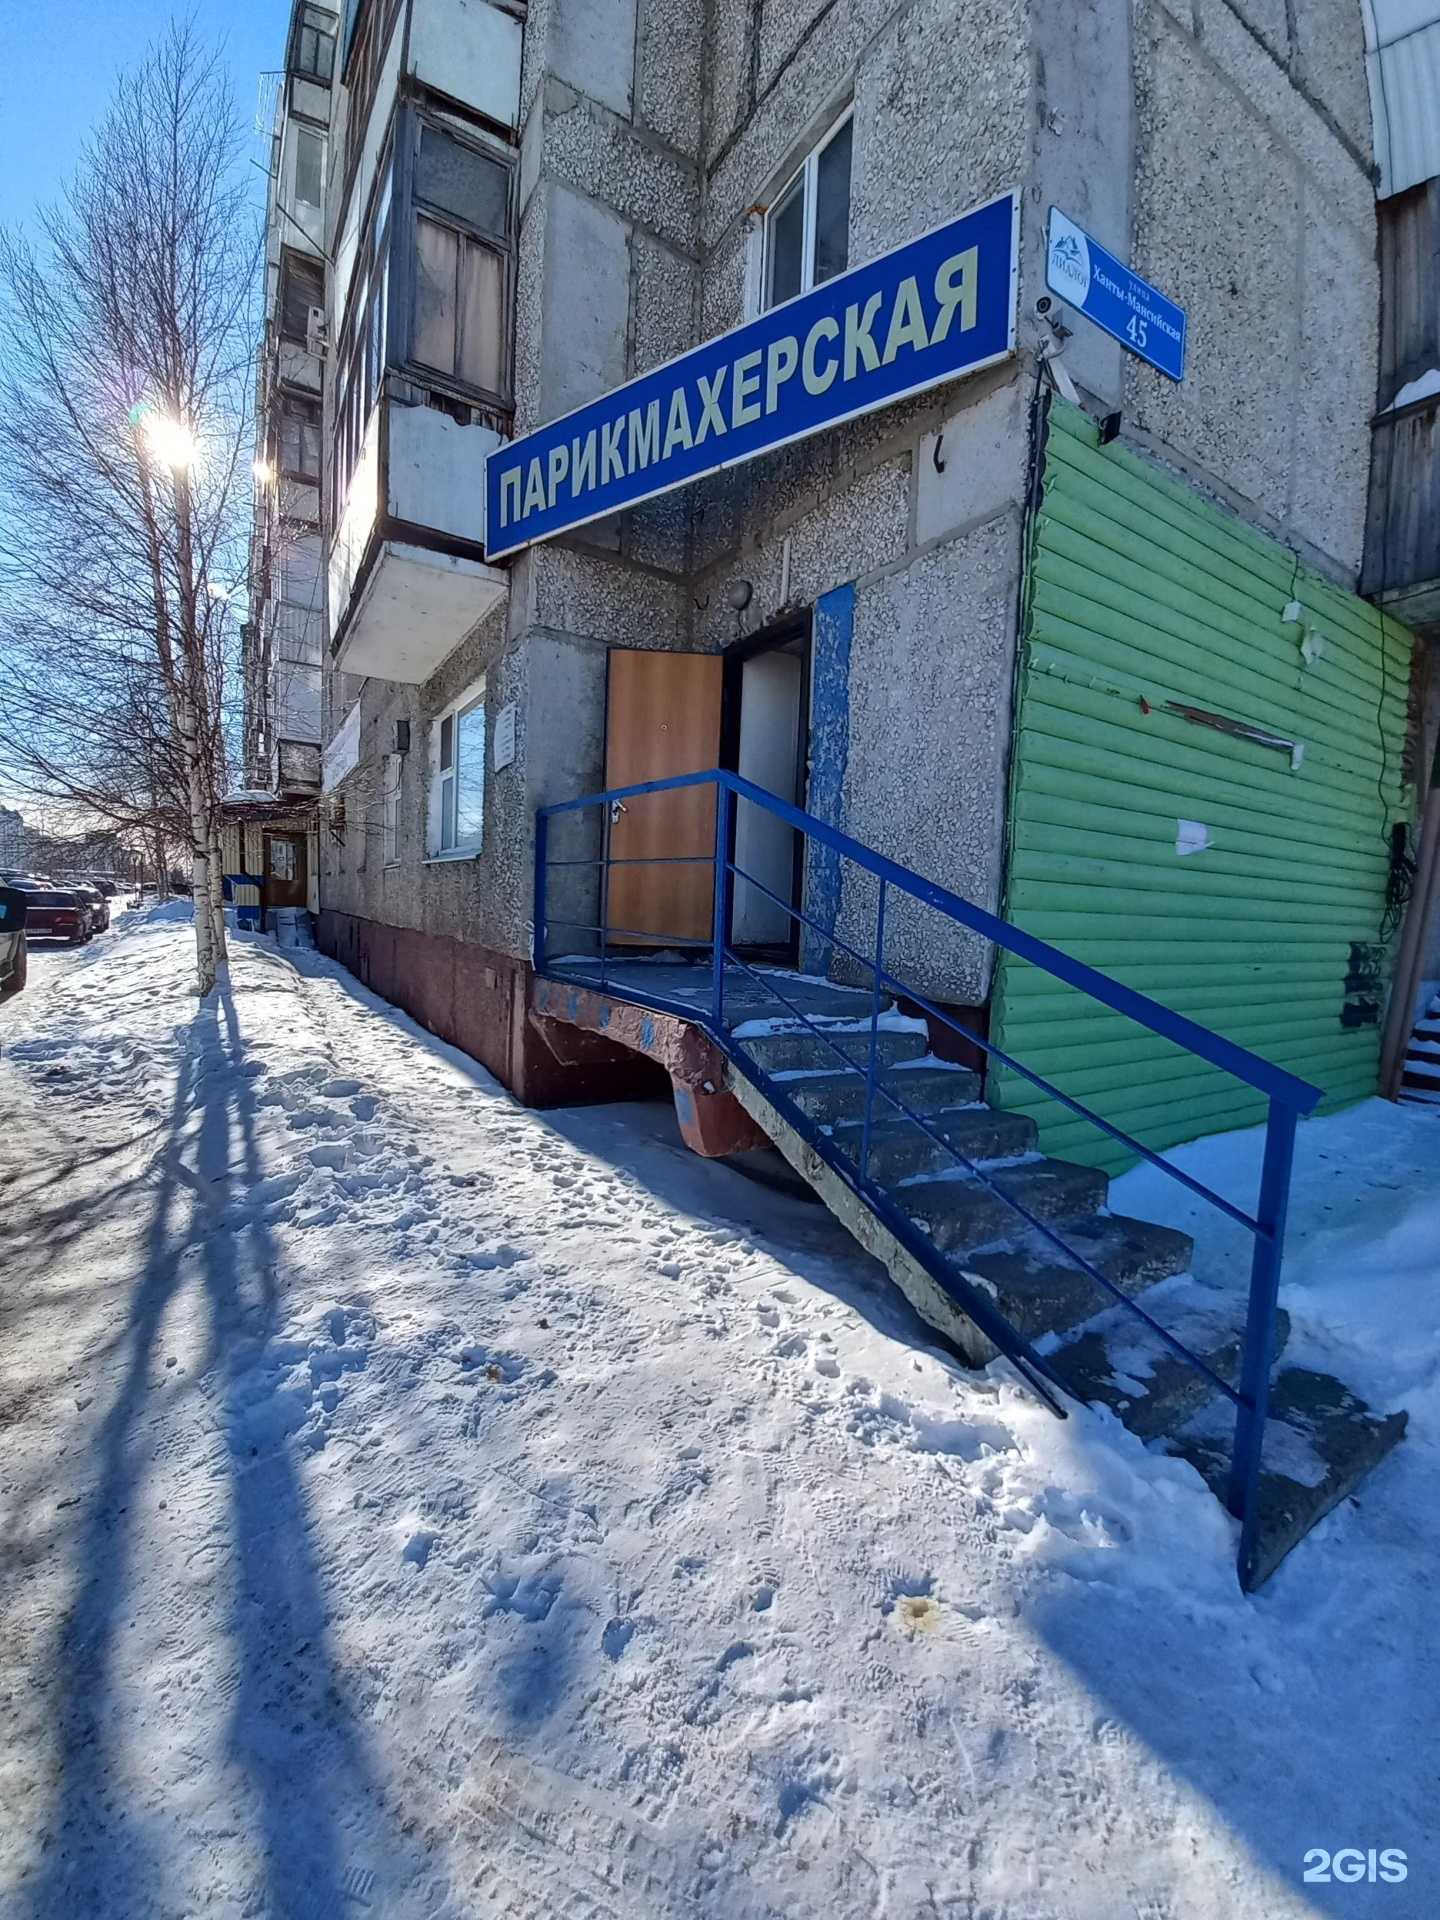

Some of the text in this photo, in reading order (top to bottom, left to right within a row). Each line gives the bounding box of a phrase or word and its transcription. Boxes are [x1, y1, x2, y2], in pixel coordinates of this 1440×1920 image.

[1093, 264, 1181, 342] Ханты-Мансийская
[1126, 314, 1148, 348] 45
[499, 245, 979, 529] ПАРИКМАХЕРСКАЯ
